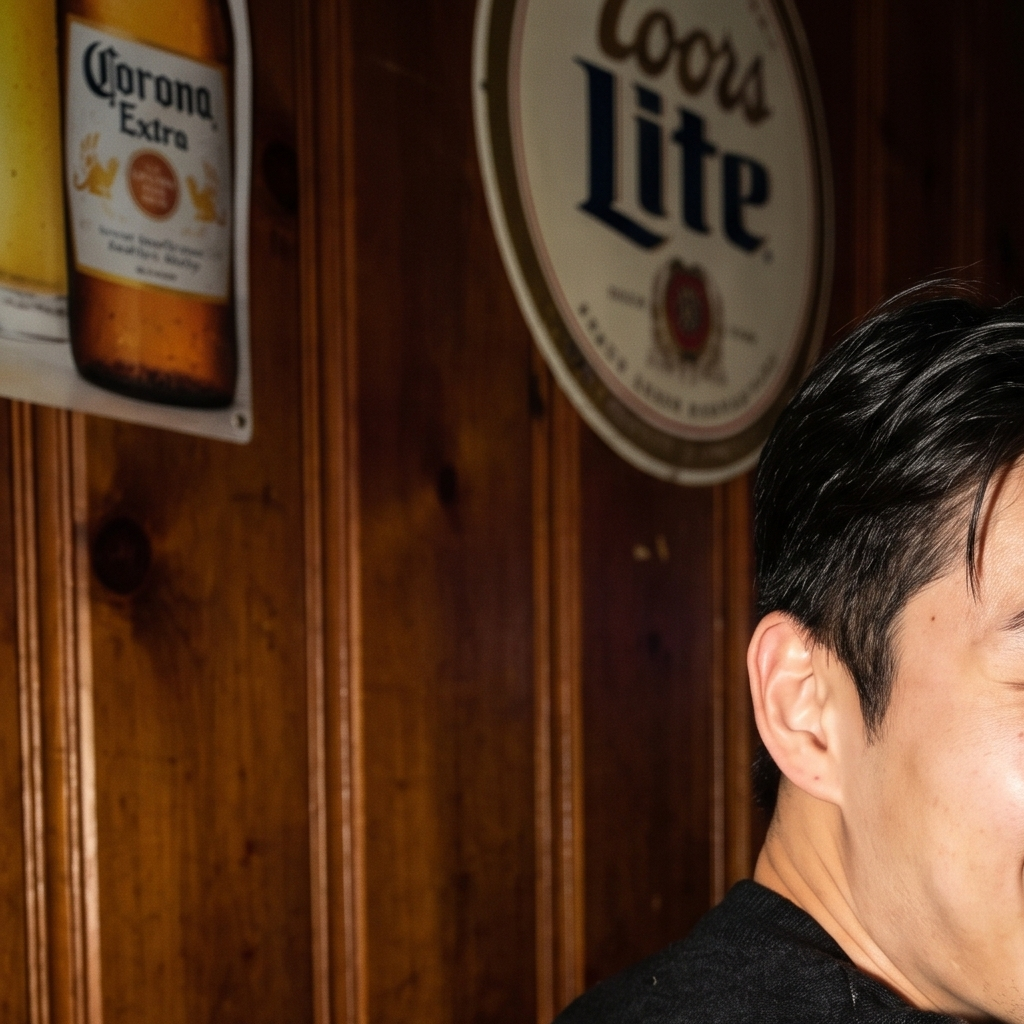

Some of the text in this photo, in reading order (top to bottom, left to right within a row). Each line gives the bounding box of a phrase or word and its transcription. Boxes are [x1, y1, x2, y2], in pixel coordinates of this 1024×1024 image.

[84, 41, 212, 119] Corona
[120, 101, 188, 150] Extra
[575, 57, 768, 252] Lite
